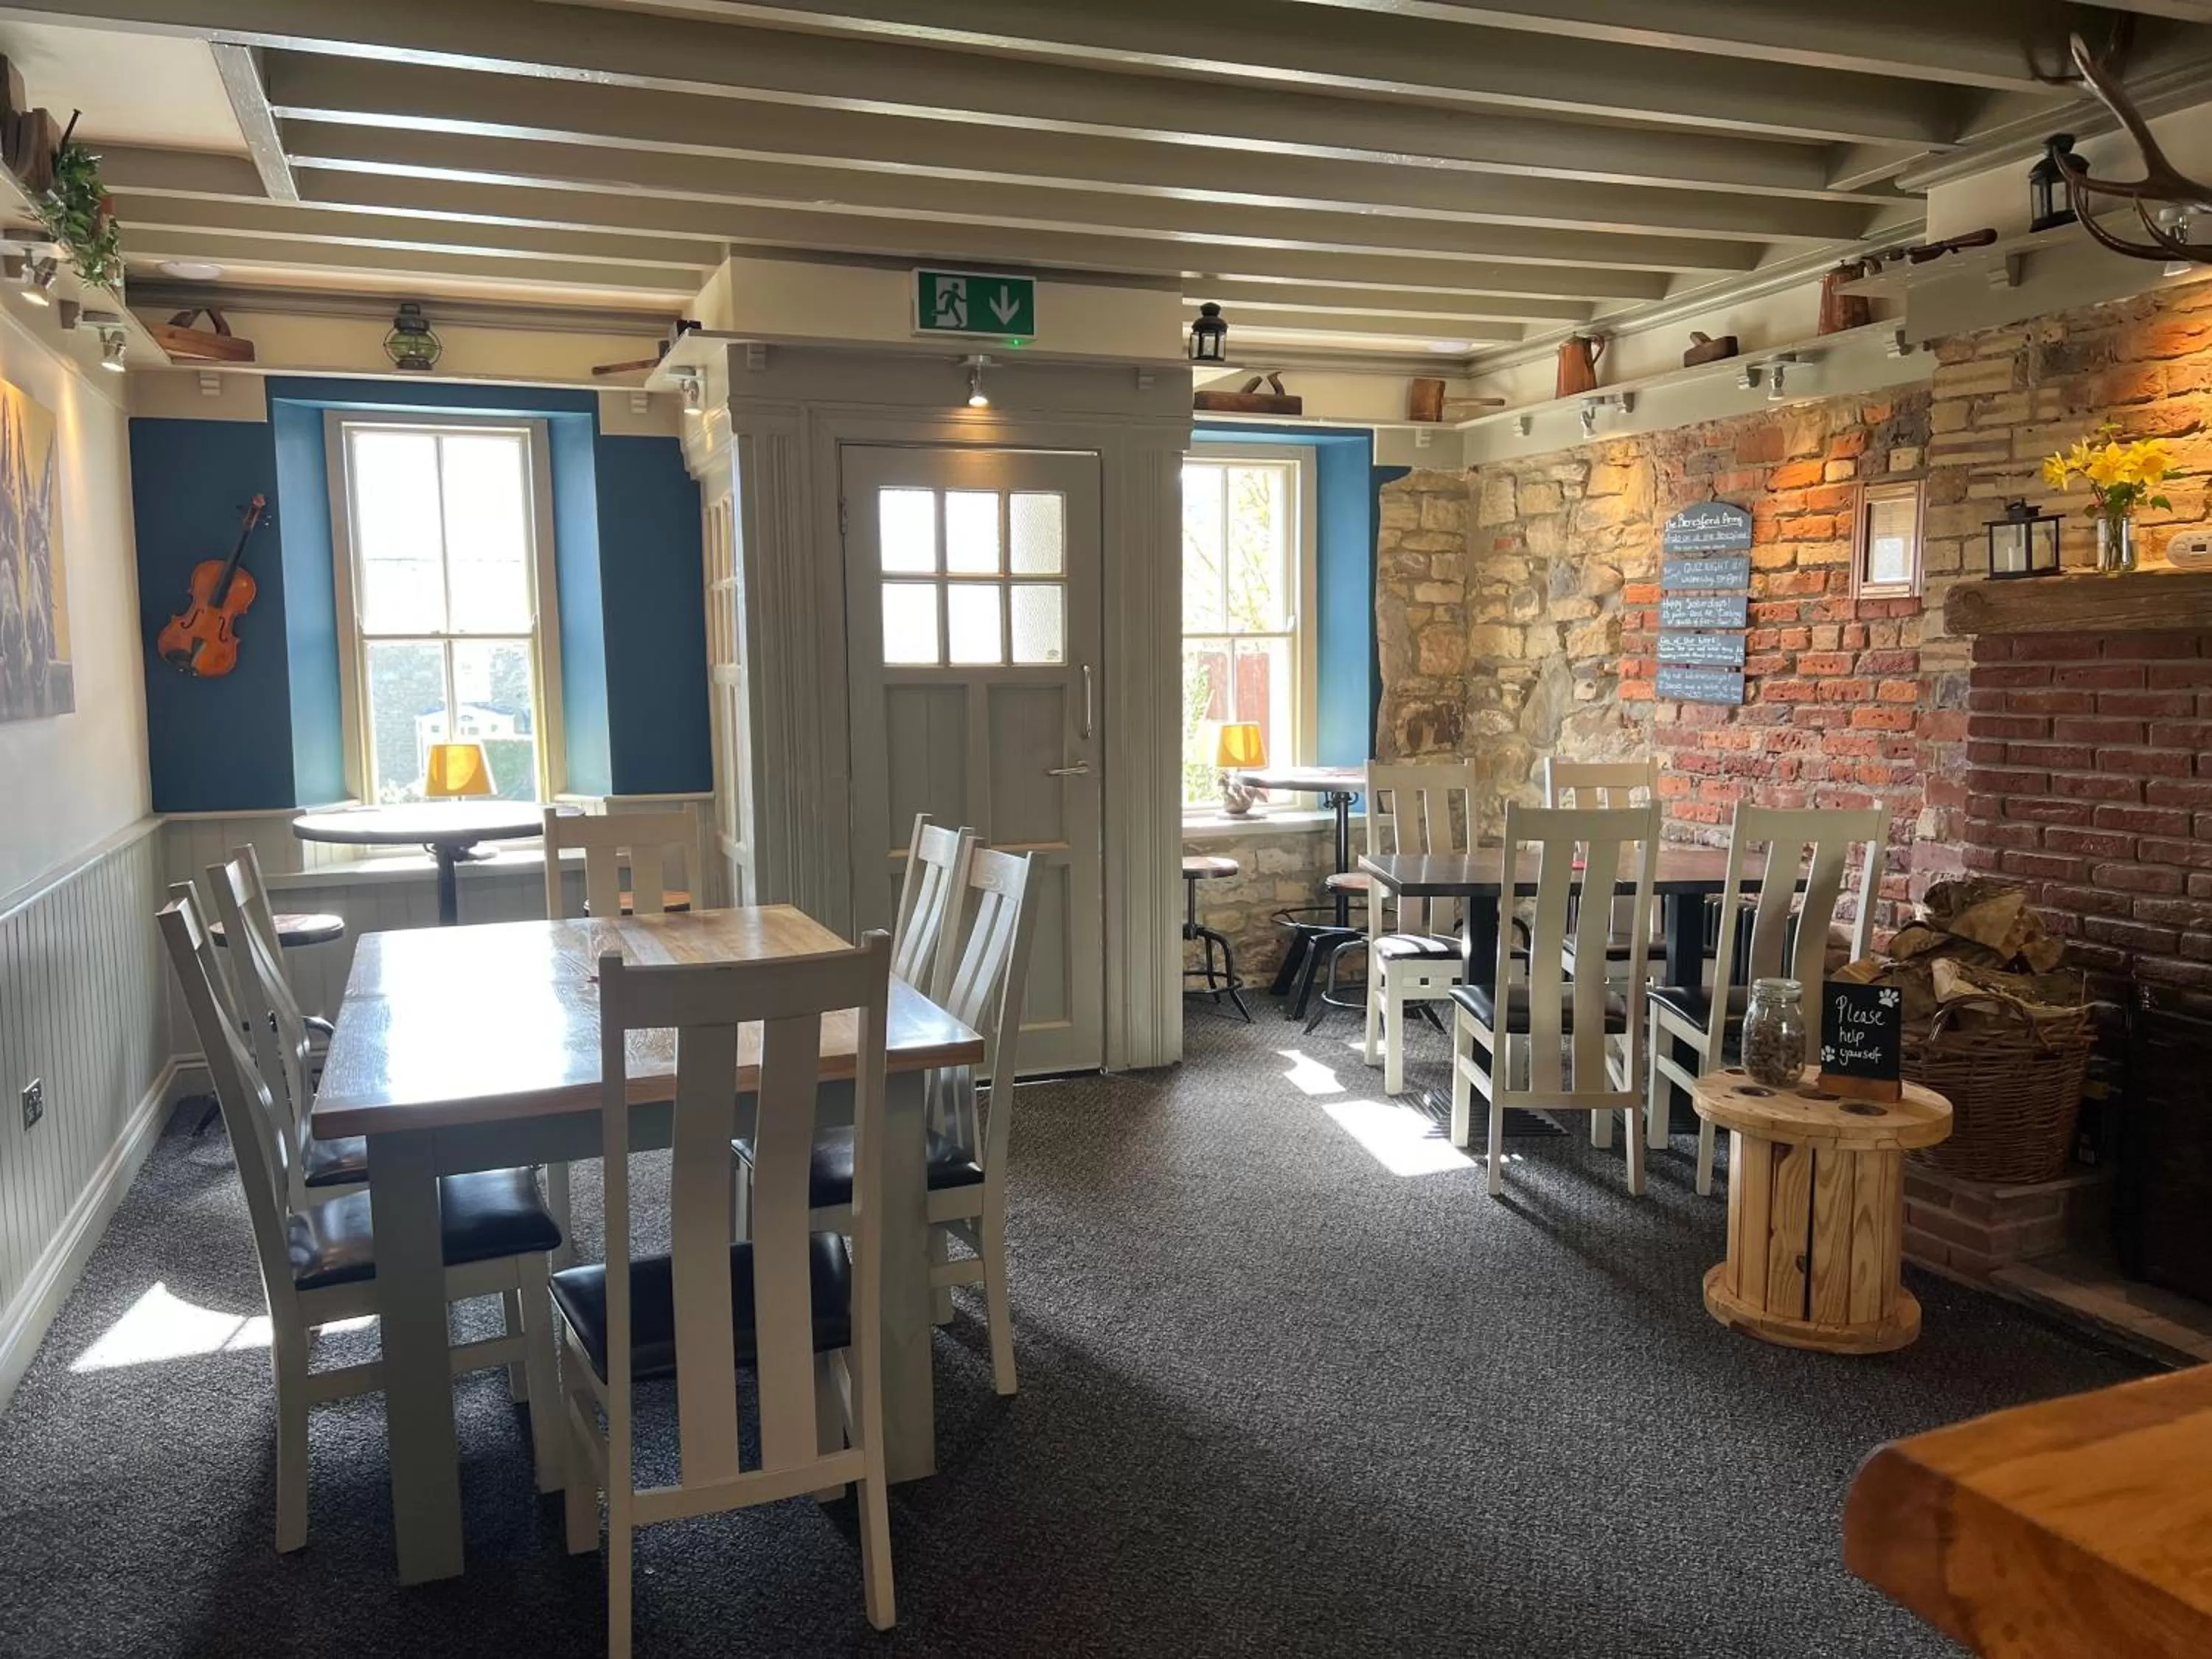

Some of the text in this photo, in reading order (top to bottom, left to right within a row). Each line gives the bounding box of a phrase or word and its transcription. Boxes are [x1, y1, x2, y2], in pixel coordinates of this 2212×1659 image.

[1836, 995, 1886, 1026] Please
[1839, 1026, 1865, 1046] help
[1840, 1047, 1882, 1065] yourself
